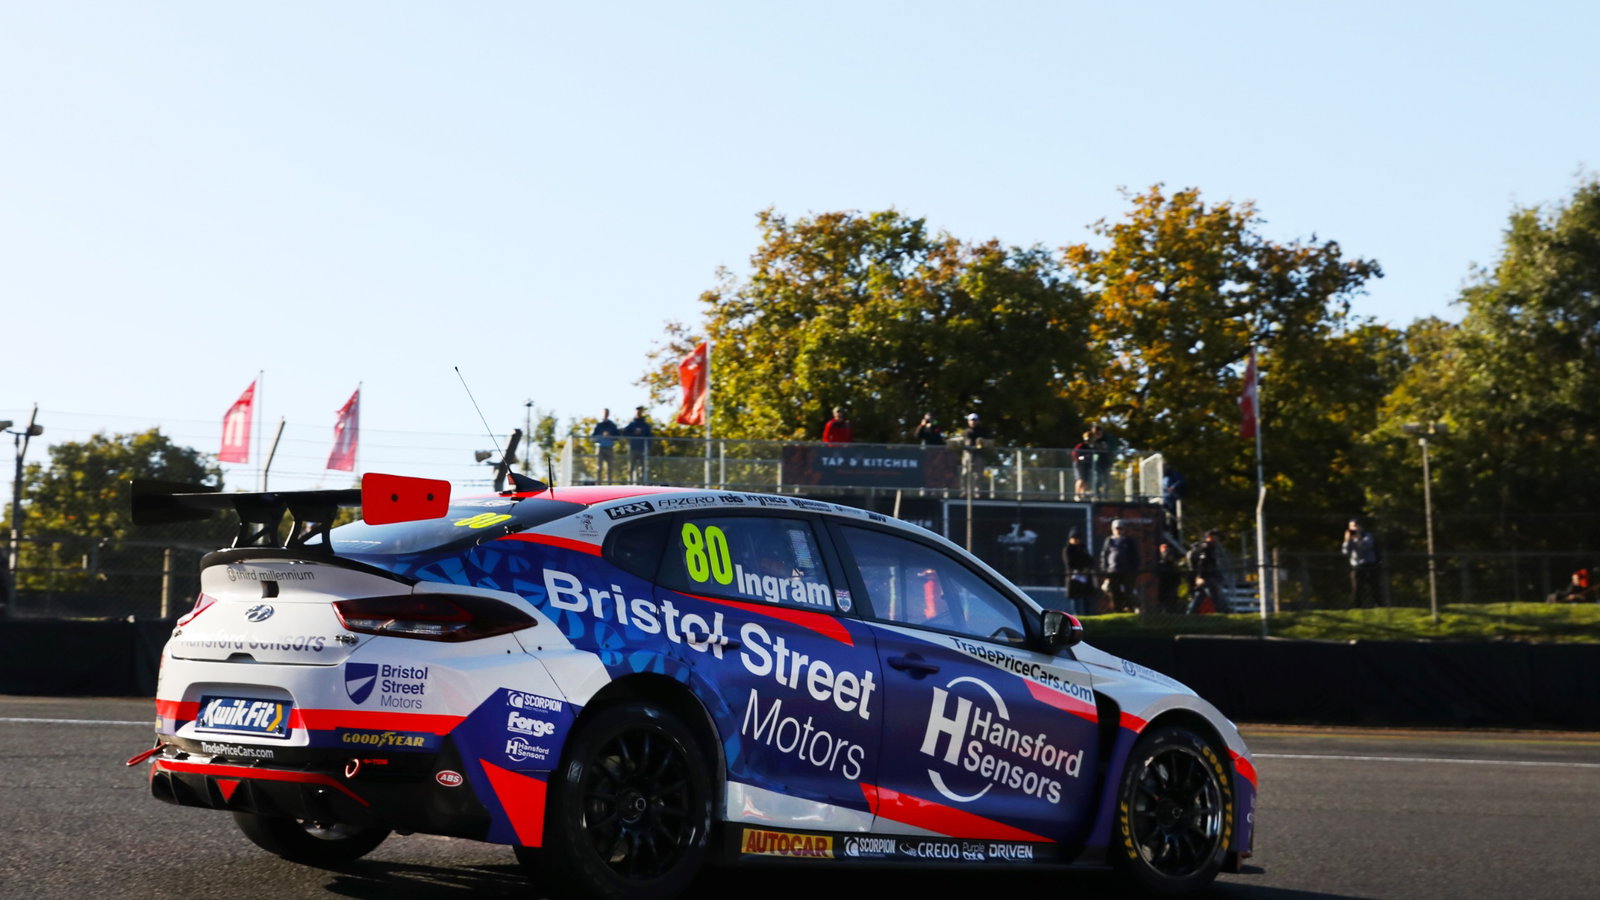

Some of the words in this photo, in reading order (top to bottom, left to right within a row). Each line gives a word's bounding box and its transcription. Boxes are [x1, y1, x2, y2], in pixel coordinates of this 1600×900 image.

[822, 457, 844, 466] TAP
[863, 458, 918, 468] KITCHEN
[681, 522, 733, 585] 80
[236, 570, 257, 580] third
[259, 569, 315, 581] millennium
[735, 565, 832, 607] Ingram
[542, 567, 727, 660] Bristol
[740, 623, 876, 720] Street
[381, 664, 429, 680] Bristol
[949, 637, 1093, 703] TradePriceCars.com
[381, 680, 425, 695] Street
[380, 694, 423, 709] Motors
[524, 694, 562, 712] SCORPION
[742, 689, 865, 781] Motors
[970, 706, 1084, 778] Hansford
[201, 742, 274, 758] TradePriceCars.com
[517, 749, 545, 760] Sensors
[518, 743, 549, 755] Hansford
[439, 774, 460, 784] ABS
[963, 742, 1062, 805] Sensors
[746, 830, 828, 858] AUTOCAR
[859, 837, 896, 854] SCORPION
[917, 842, 959, 859] CREDO
[962, 842, 985, 852] Purple
[989, 844, 1033, 859] DRIVEN
